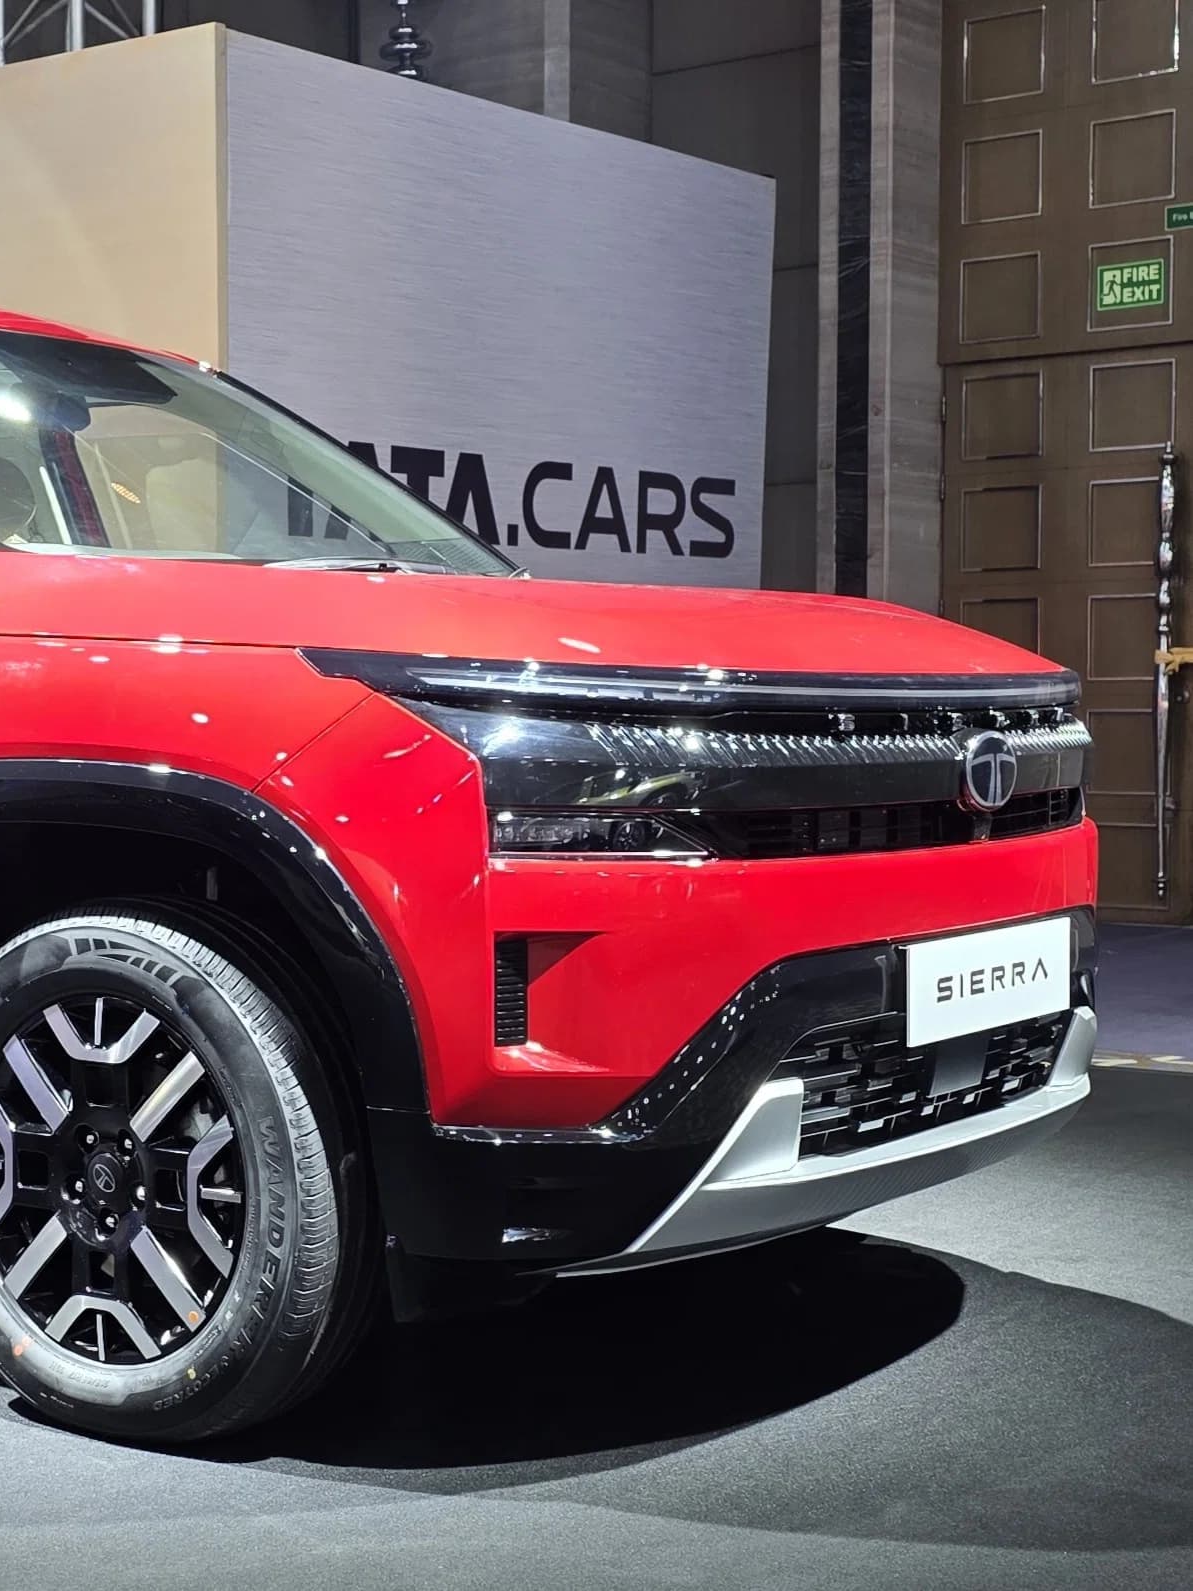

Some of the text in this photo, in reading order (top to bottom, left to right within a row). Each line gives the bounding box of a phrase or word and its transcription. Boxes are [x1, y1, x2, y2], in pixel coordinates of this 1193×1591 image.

[1122, 264, 1160, 283] FIRE
[1122, 284, 1161, 303] EXIT
[287, 440, 736, 559] TA.CARS
[937, 957, 1049, 1004] SIERRA
